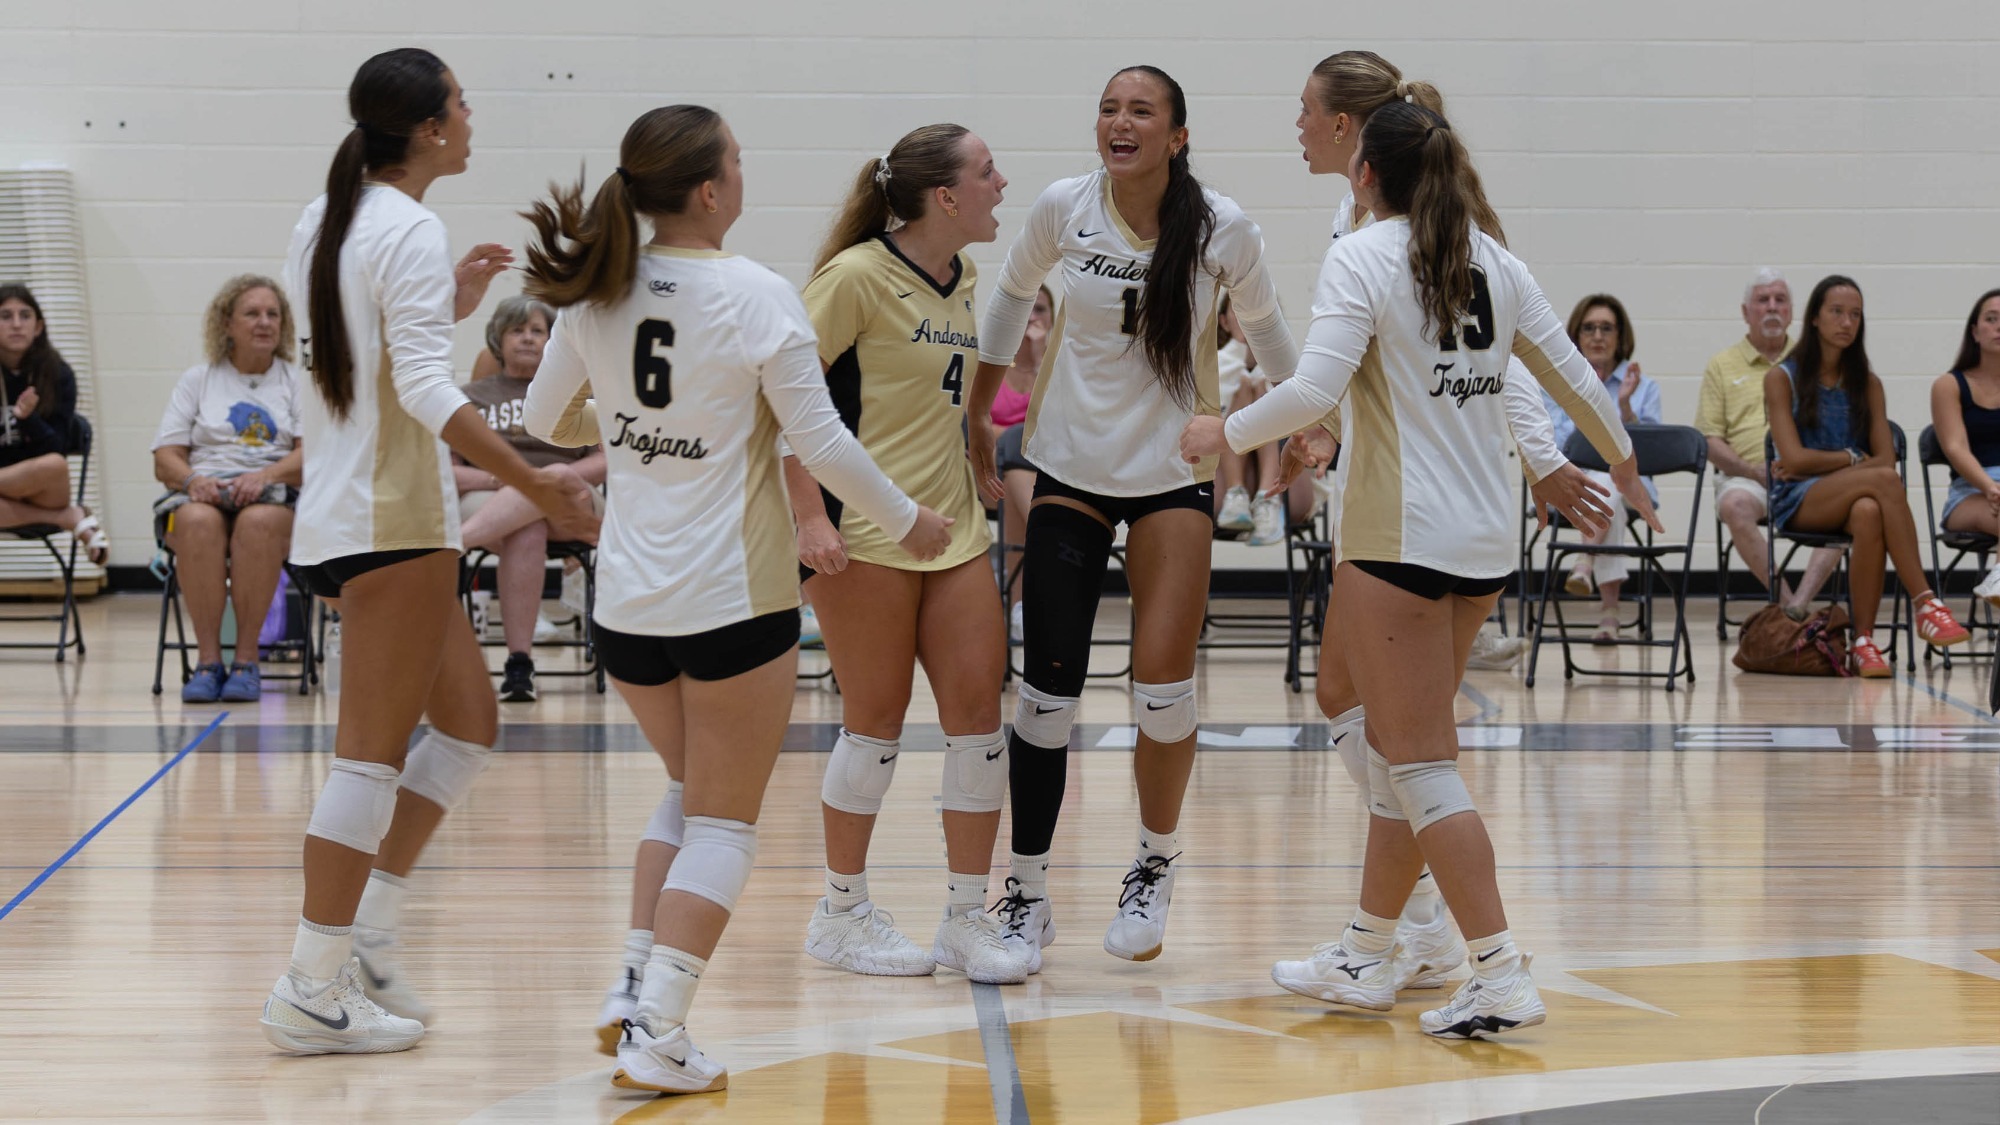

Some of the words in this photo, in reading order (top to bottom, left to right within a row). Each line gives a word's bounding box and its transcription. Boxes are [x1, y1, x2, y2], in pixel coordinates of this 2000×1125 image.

[651, 280, 677, 294] SAC
[633, 317, 676, 409] 6
[942, 351, 965, 407] 4
[1429, 363, 1504, 409] Trojans
[477, 398, 524, 431] ASE
[610, 412, 710, 465] Trojans
